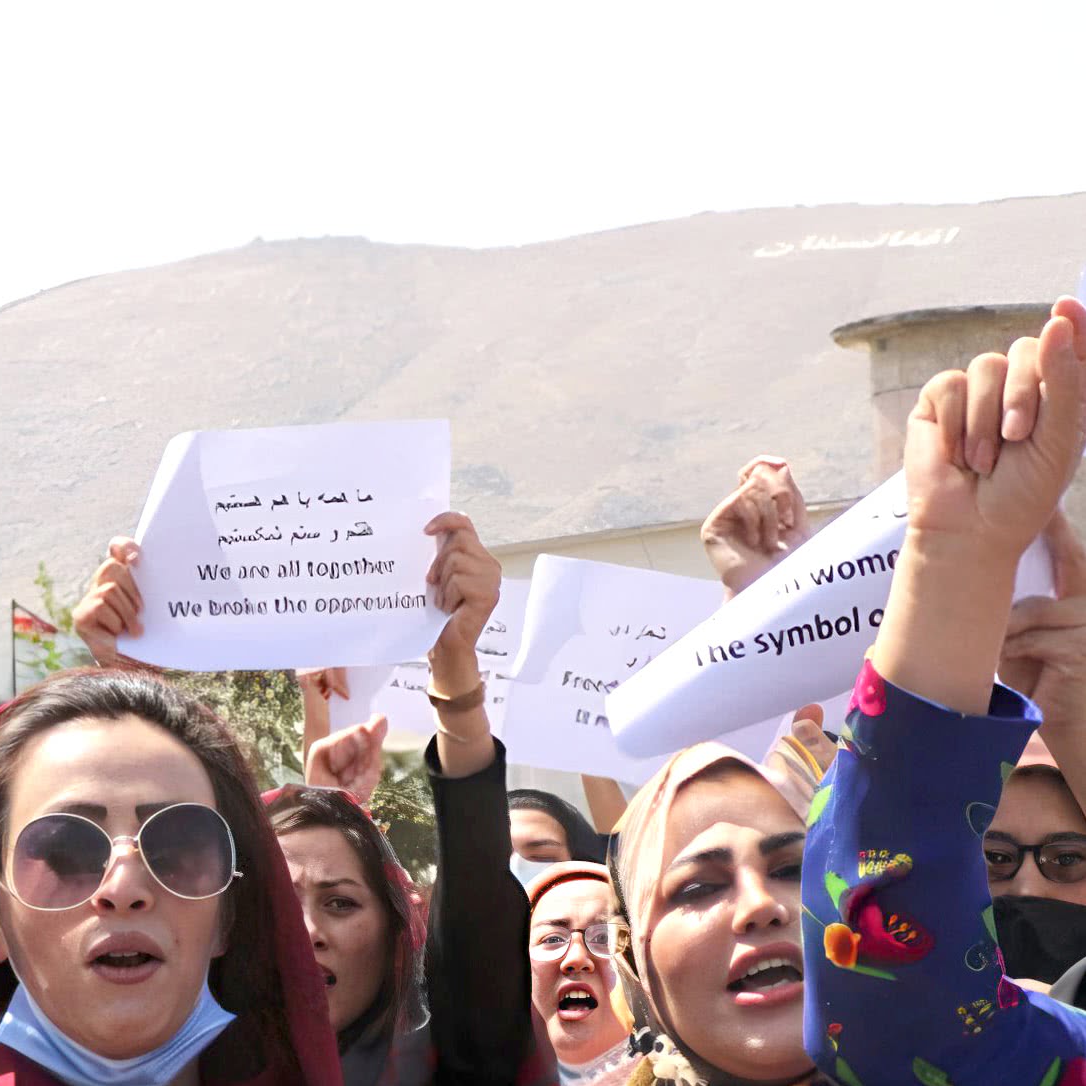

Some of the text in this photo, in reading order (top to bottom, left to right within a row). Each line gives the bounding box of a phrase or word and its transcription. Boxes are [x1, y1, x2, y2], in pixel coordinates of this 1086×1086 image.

[196, 563, 231, 581] We
[237, 565, 270, 580] are
[277, 559, 301, 579] all
[167, 600, 203, 619] We
[274, 596, 308, 615] the
[753, 606, 859, 655] symbol
[868, 608, 885, 629] o
